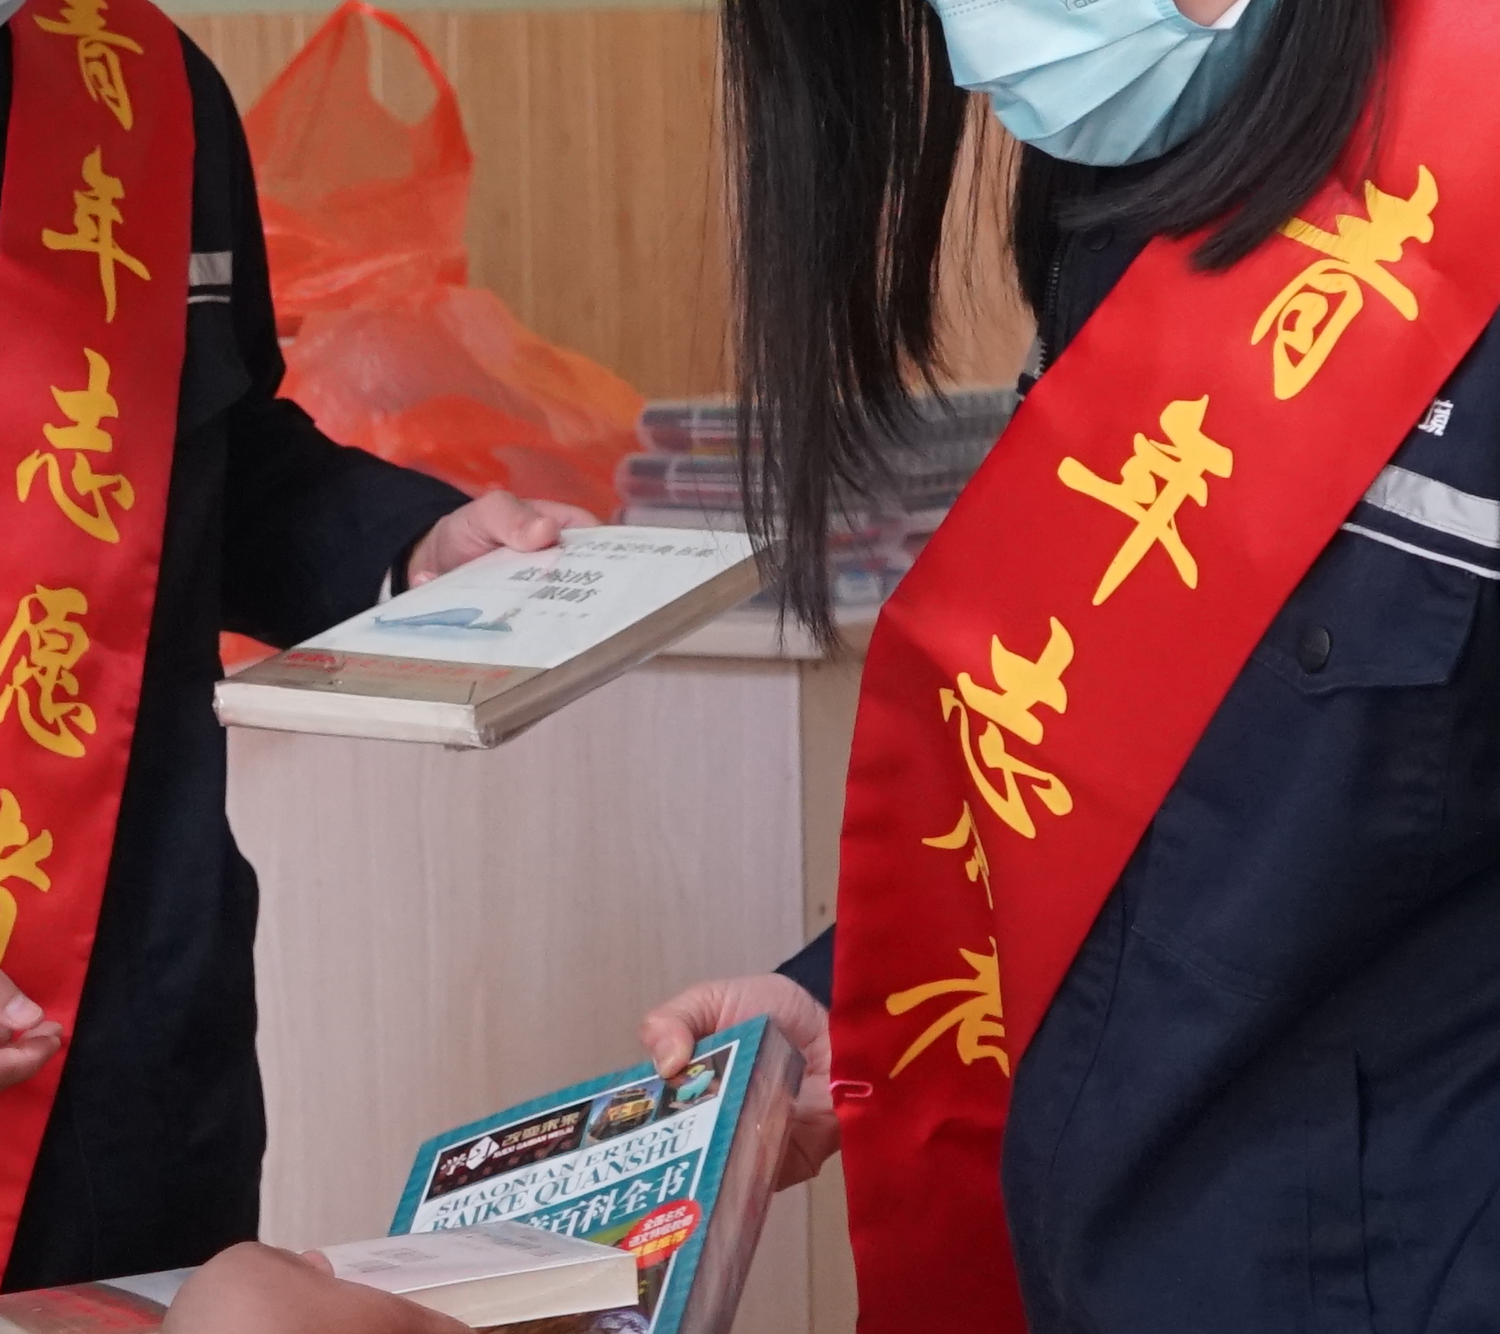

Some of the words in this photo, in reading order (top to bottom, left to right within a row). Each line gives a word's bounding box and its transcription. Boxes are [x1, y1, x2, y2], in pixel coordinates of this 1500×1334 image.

[436, 1161, 579, 1218] SHAONIAN
[584, 1114, 699, 1166] ERTONG
[534, 1129, 695, 1205] QUANSHU
